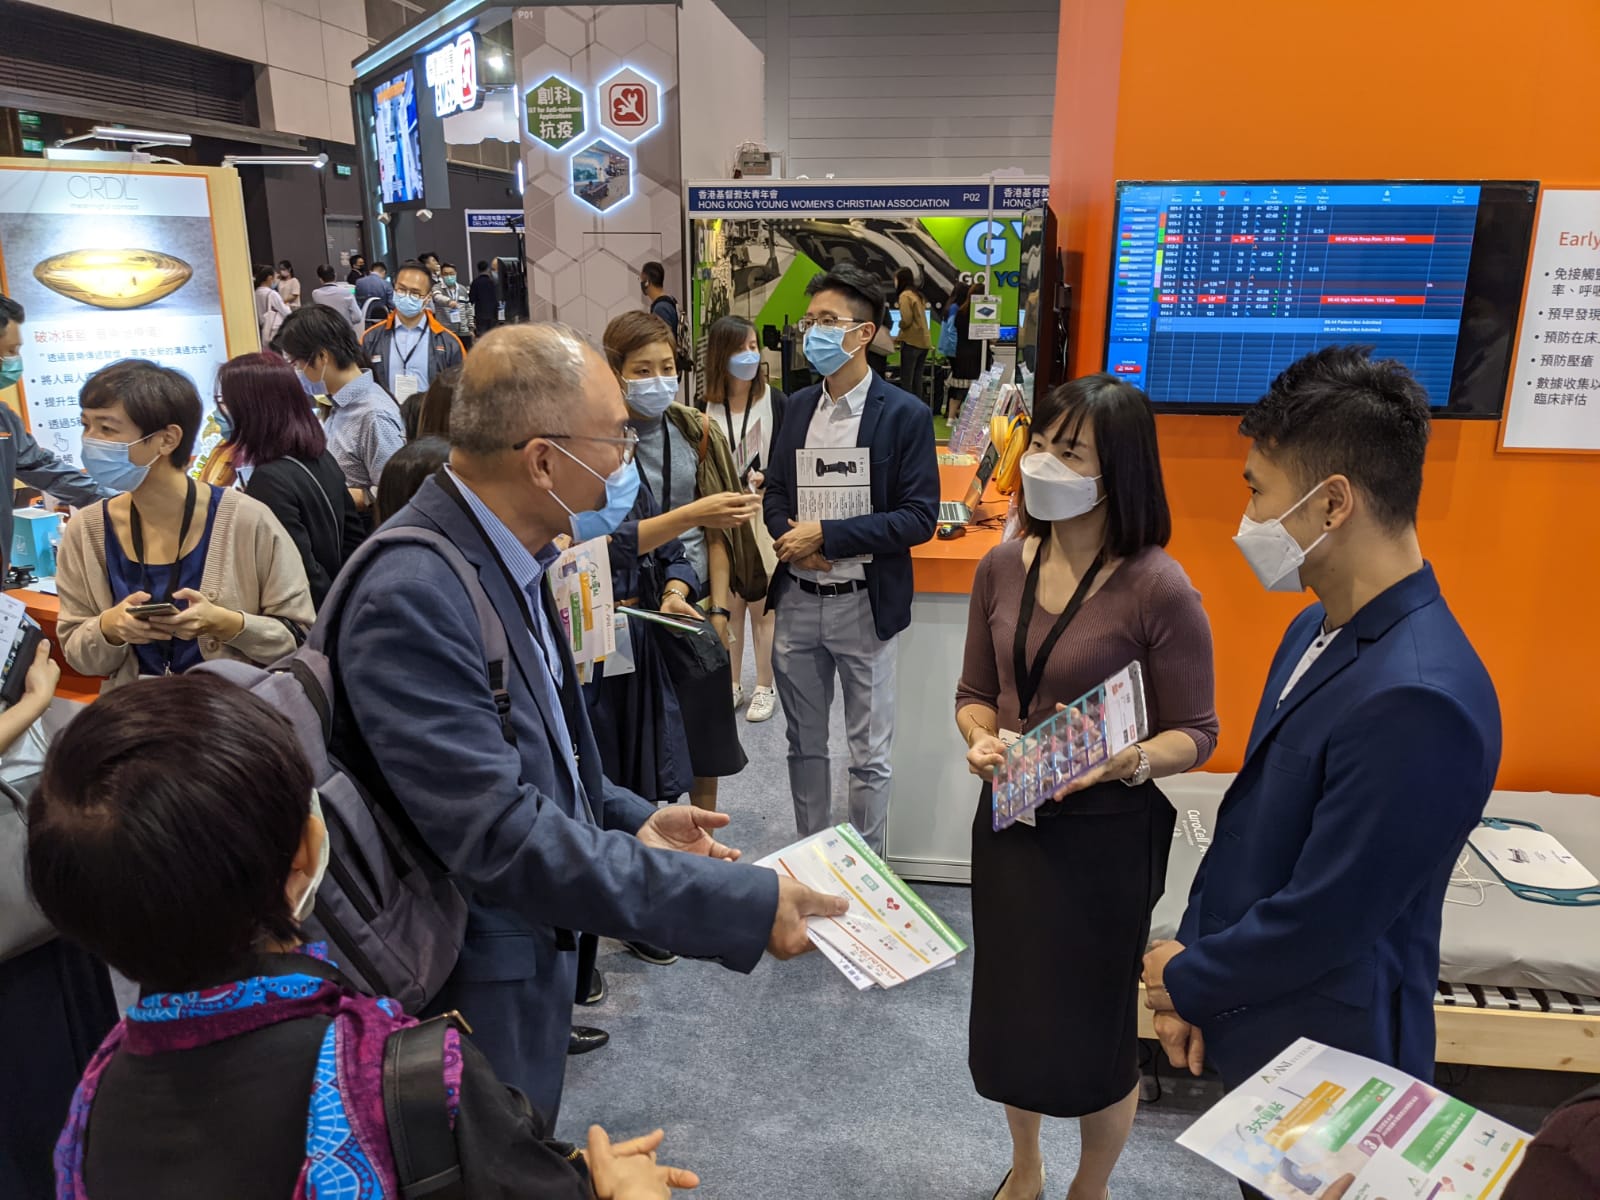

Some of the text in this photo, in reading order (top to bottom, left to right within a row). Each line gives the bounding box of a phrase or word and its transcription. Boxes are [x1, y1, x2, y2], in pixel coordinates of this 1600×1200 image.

[517, 10, 534, 20] P01
[537, 86, 571, 104] 創科
[539, 121, 573, 139] 抗疫
[67, 175, 138, 200] CRDL
[698, 190, 778, 200] 香港基督教女青年會
[963, 193, 981, 202] P02
[698, 199, 950, 210] HONG KONG YOUNG WOMEN'S CHRISTIAN ASSOCIATION
[1002, 198, 1032, 208] HONG
[1559, 231, 1600, 250] Early
[959, 271, 1021, 288] GO YO
[1554, 267, 1600, 281] 免接觸
[1544, 331, 1600, 345] 預防在床
[41, 373, 89, 386] 將人與人
[1533, 392, 1588, 407] 臨床評估
[1187, 809, 1208, 845] CuroCell
